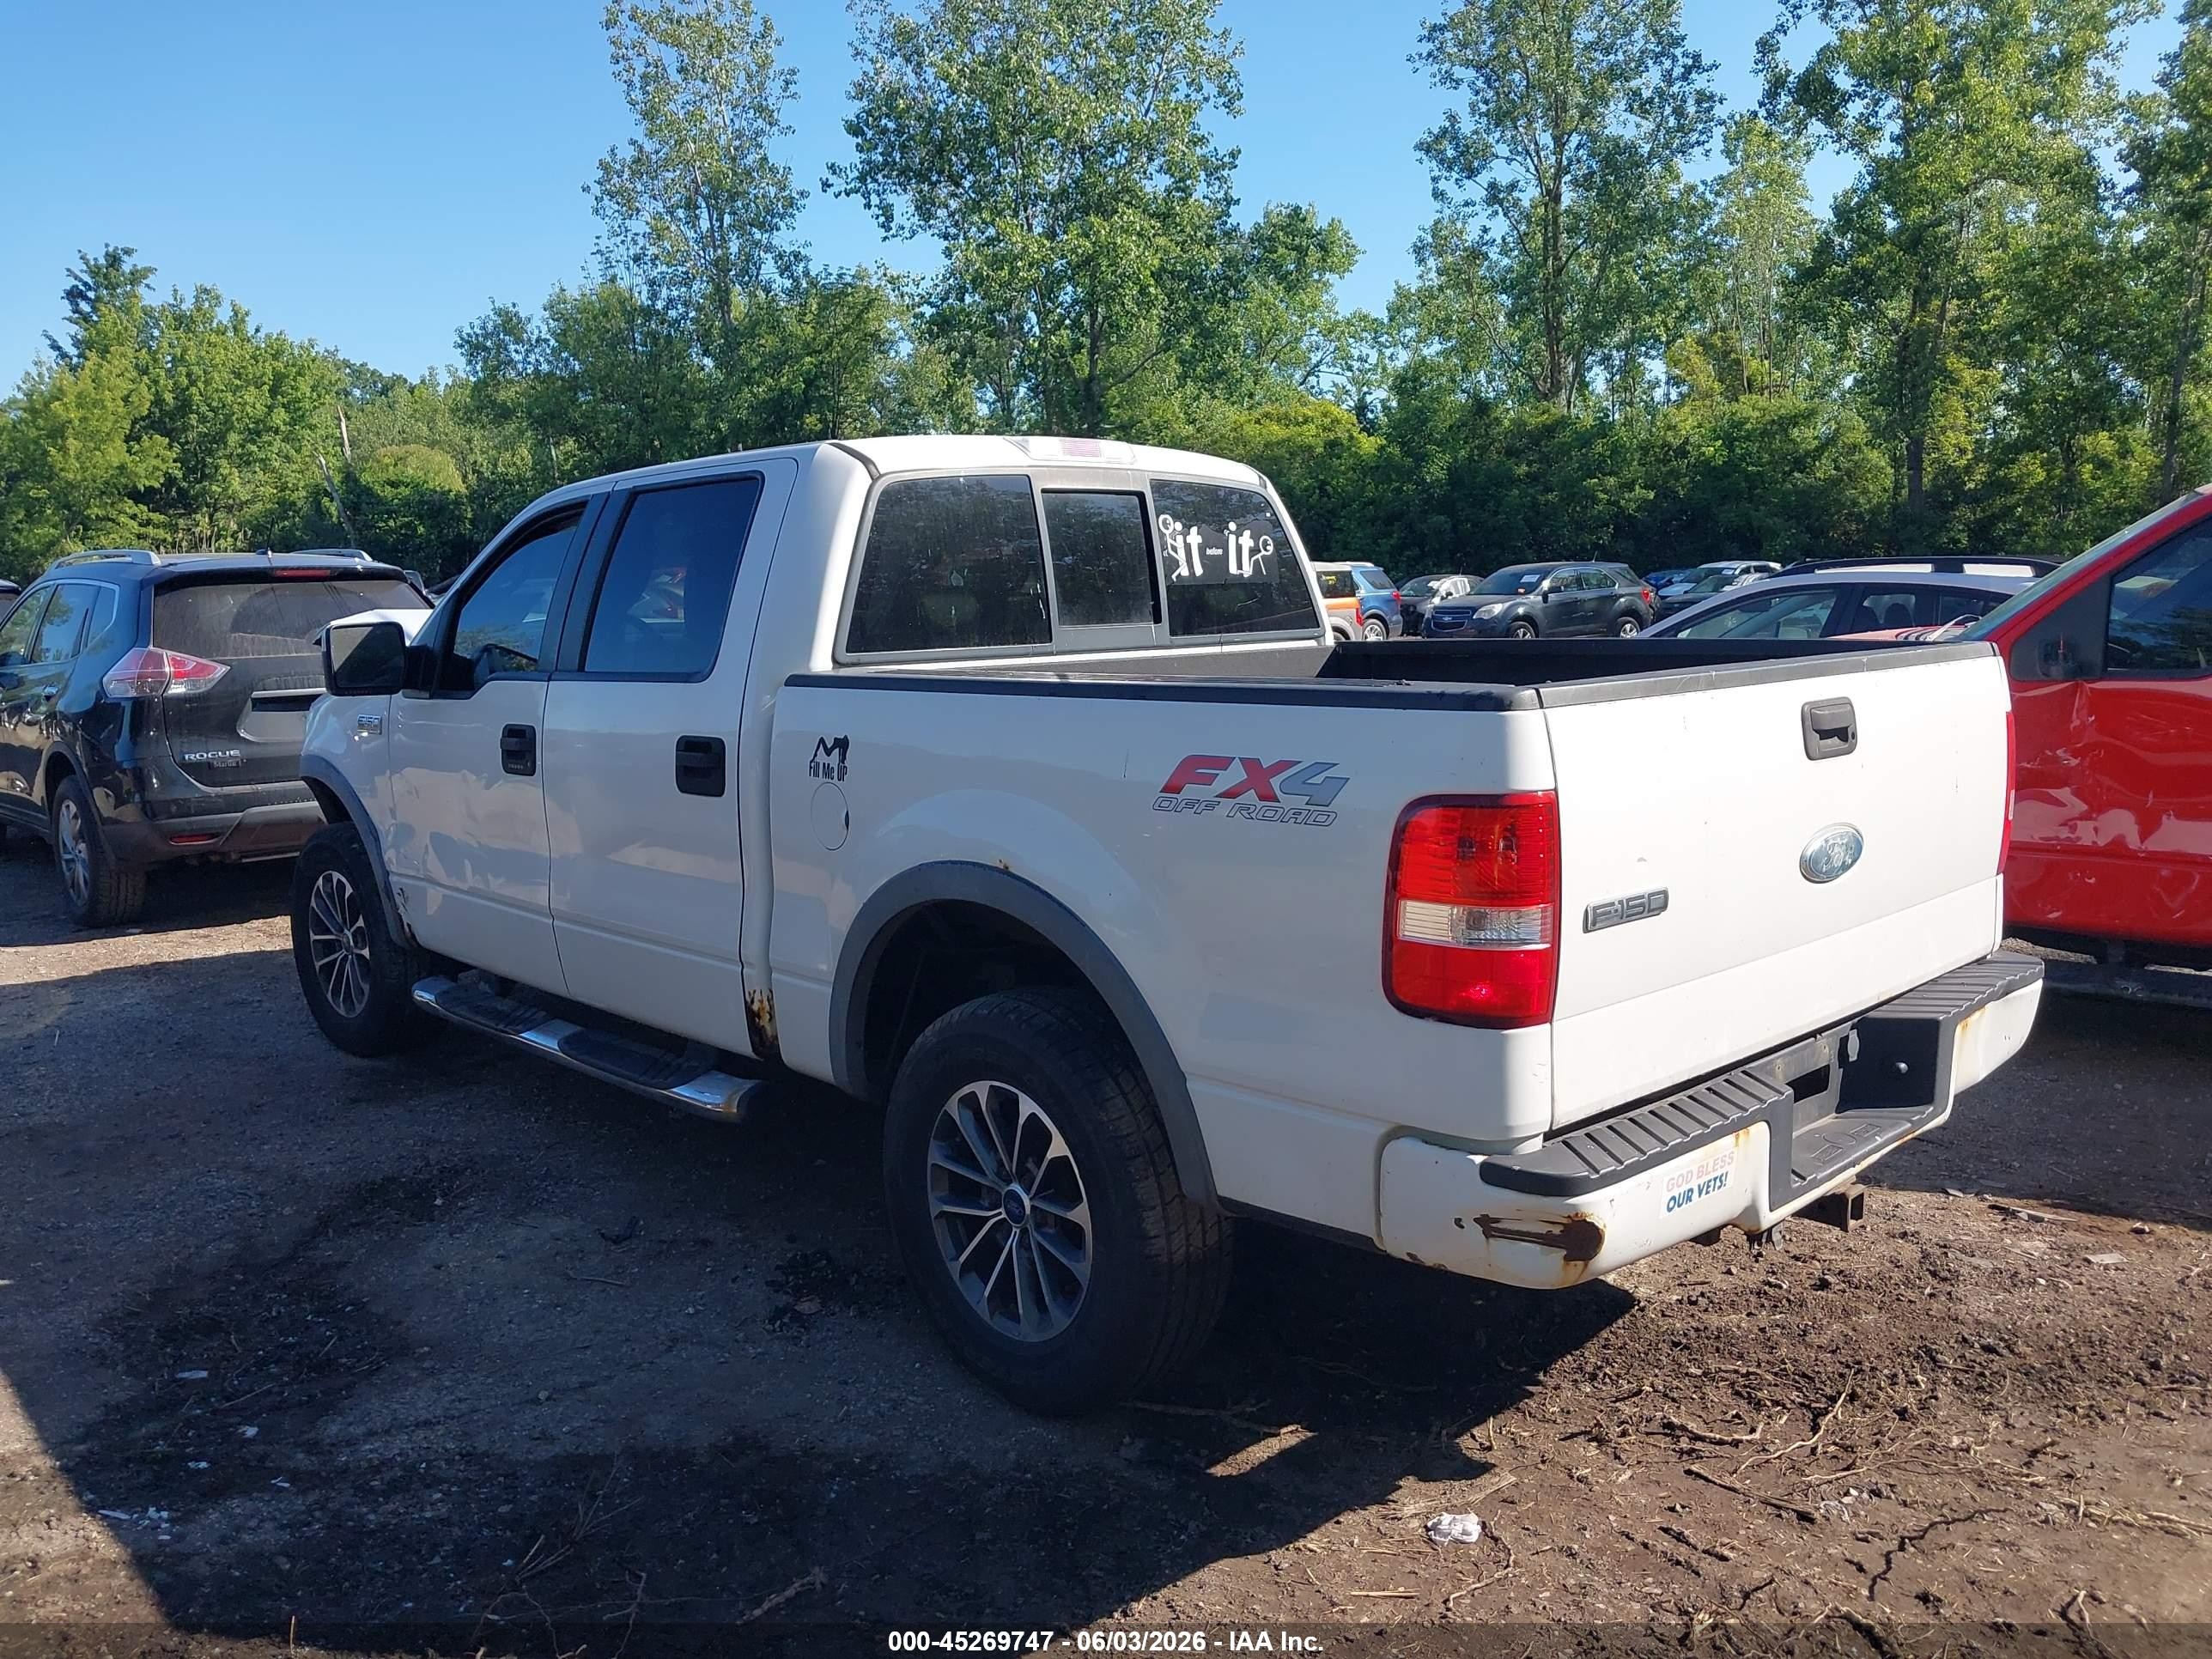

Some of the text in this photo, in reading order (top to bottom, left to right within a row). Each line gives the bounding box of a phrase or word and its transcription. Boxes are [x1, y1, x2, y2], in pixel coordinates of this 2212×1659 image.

[1206, 547, 1224, 556] before
[1228, 521, 1254, 577] it
[184, 750, 240, 762] ROGUE
[809, 761, 820, 778] Fill
[823, 763, 835, 781] Me
[1159, 754, 1351, 807] FX4
[1152, 796, 1338, 827] OFF ROAD
[1666, 1150, 1735, 1193] GOD BLESS
[1667, 1170, 1729, 1213] OUR VETS!
